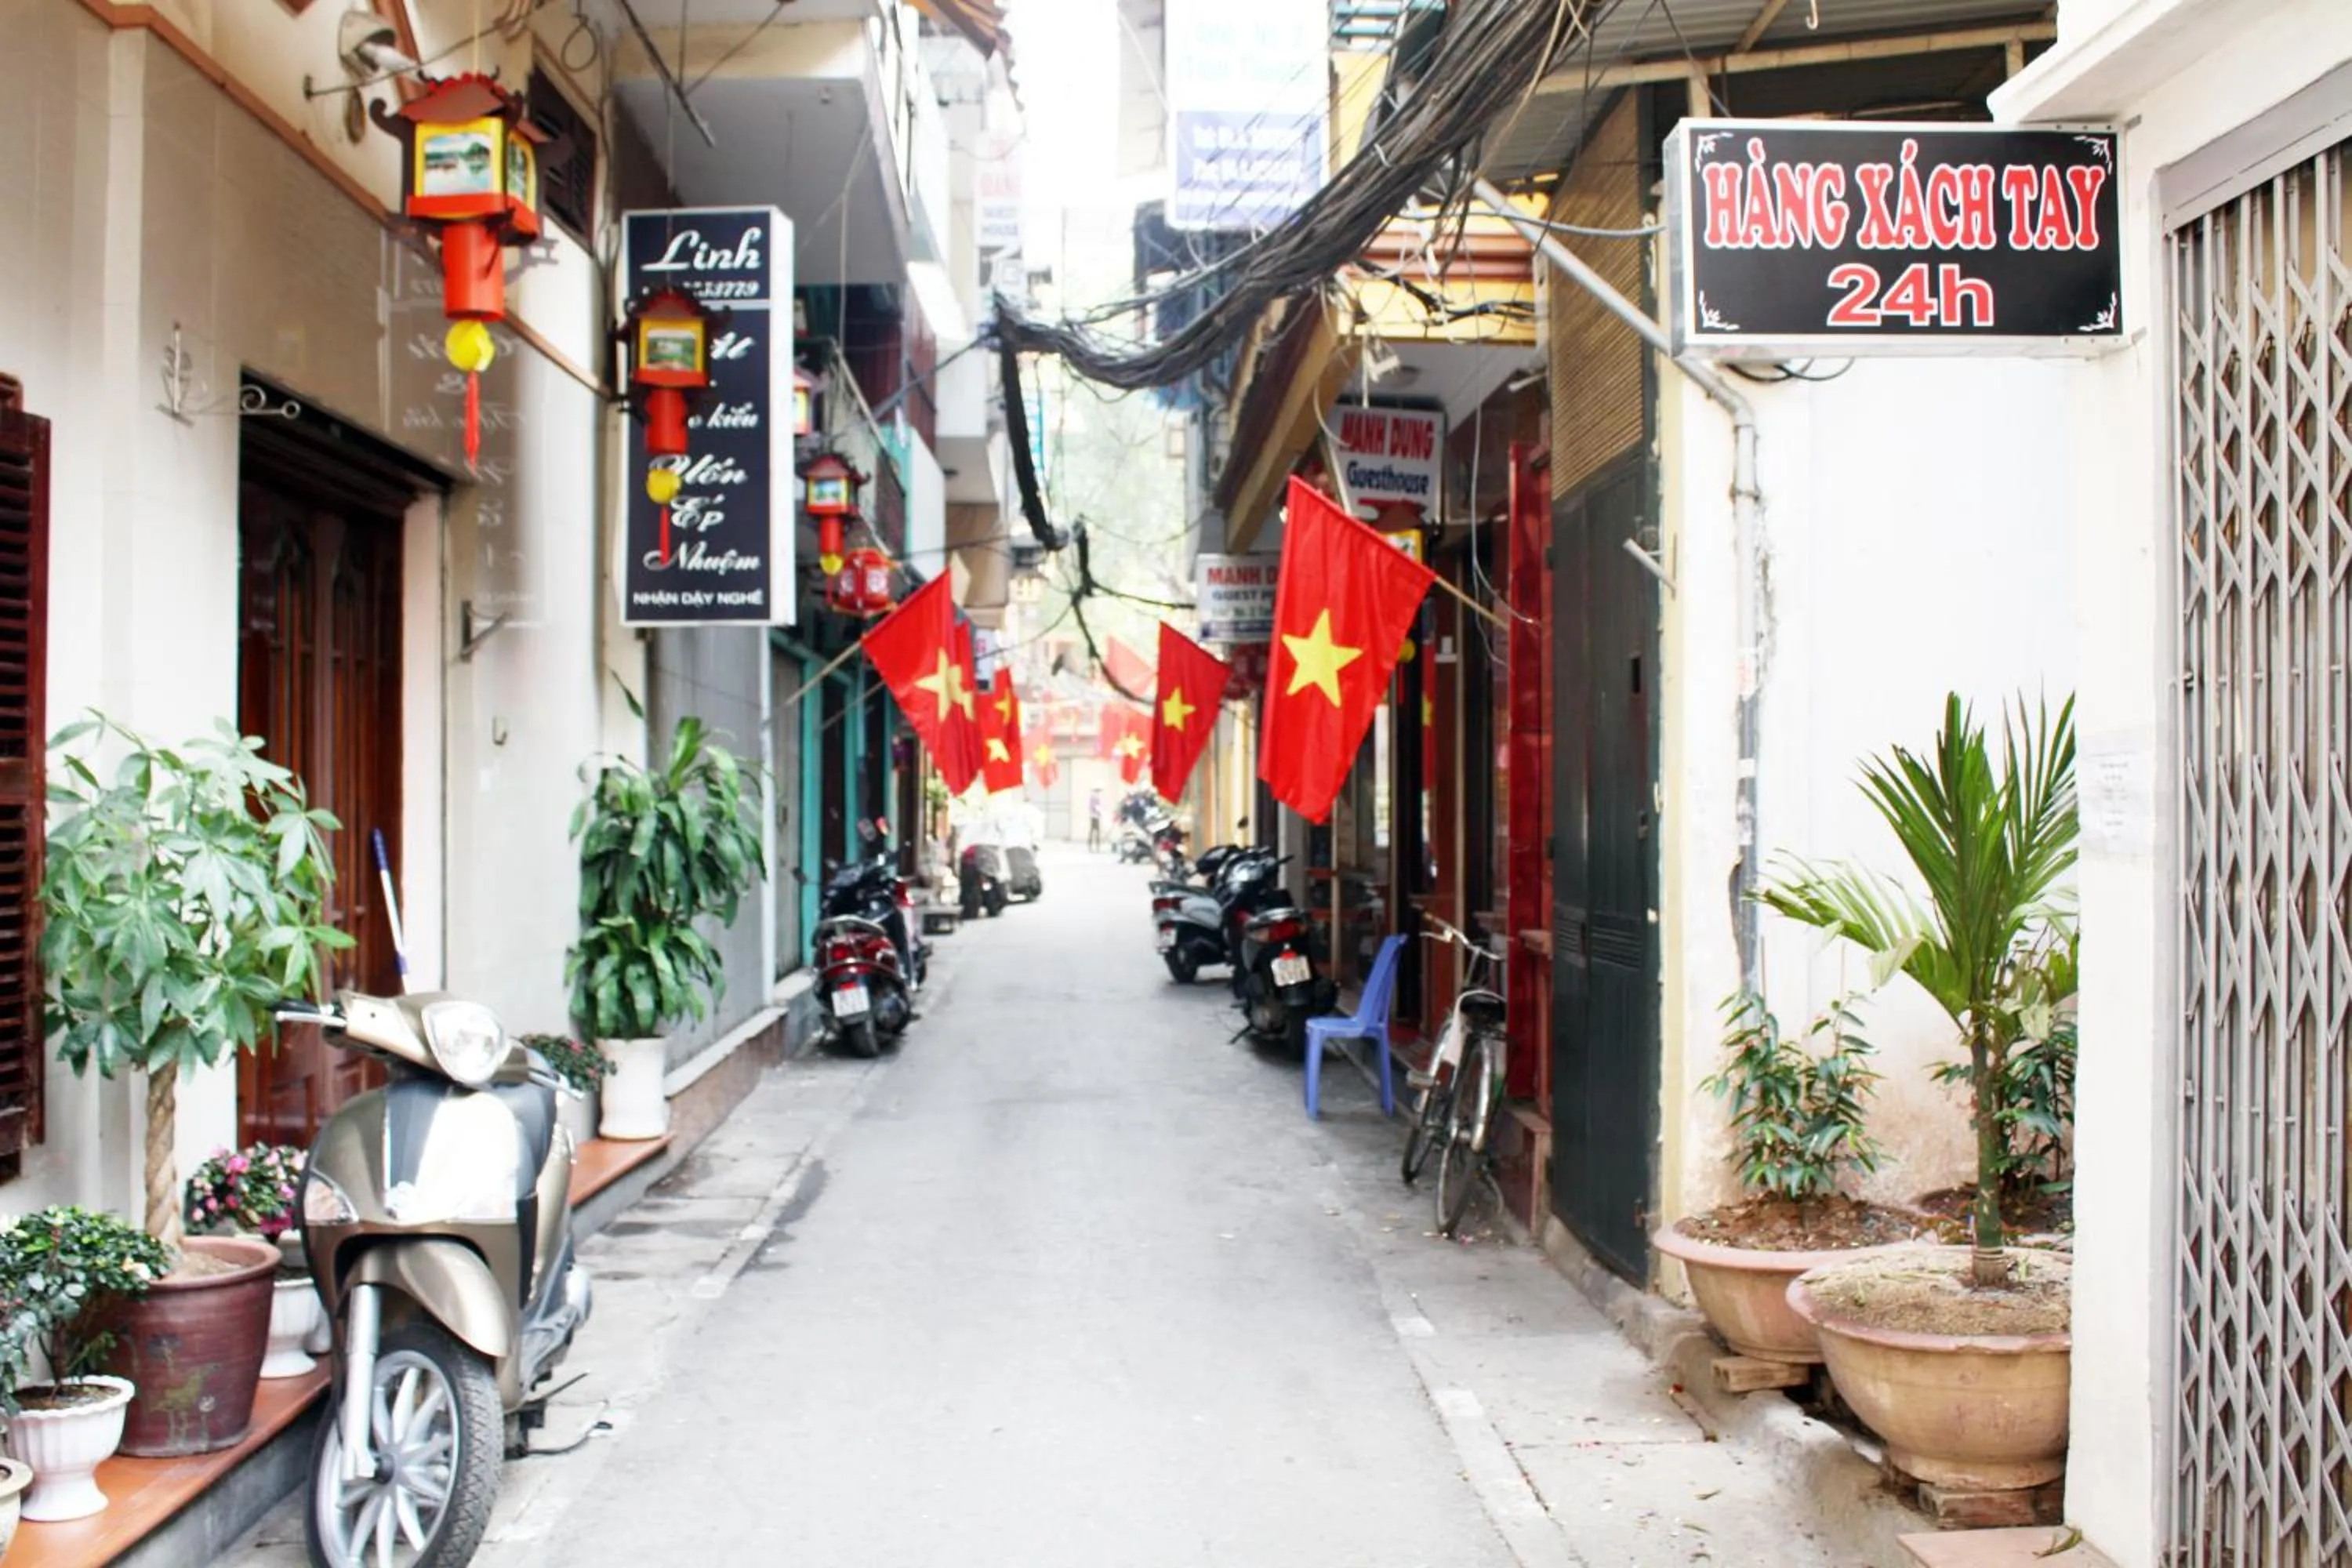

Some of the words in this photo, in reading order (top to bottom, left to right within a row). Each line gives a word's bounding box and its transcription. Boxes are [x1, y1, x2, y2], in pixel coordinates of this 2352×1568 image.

[1702, 138, 1849, 249] HÀNG
[1856, 138, 1997, 249] XÁCH
[2002, 165, 2105, 250] TAY
[641, 227, 762, 271] Linh
[1827, 263, 1994, 327] 24h
[1346, 460, 1429, 495] Guesthouse
